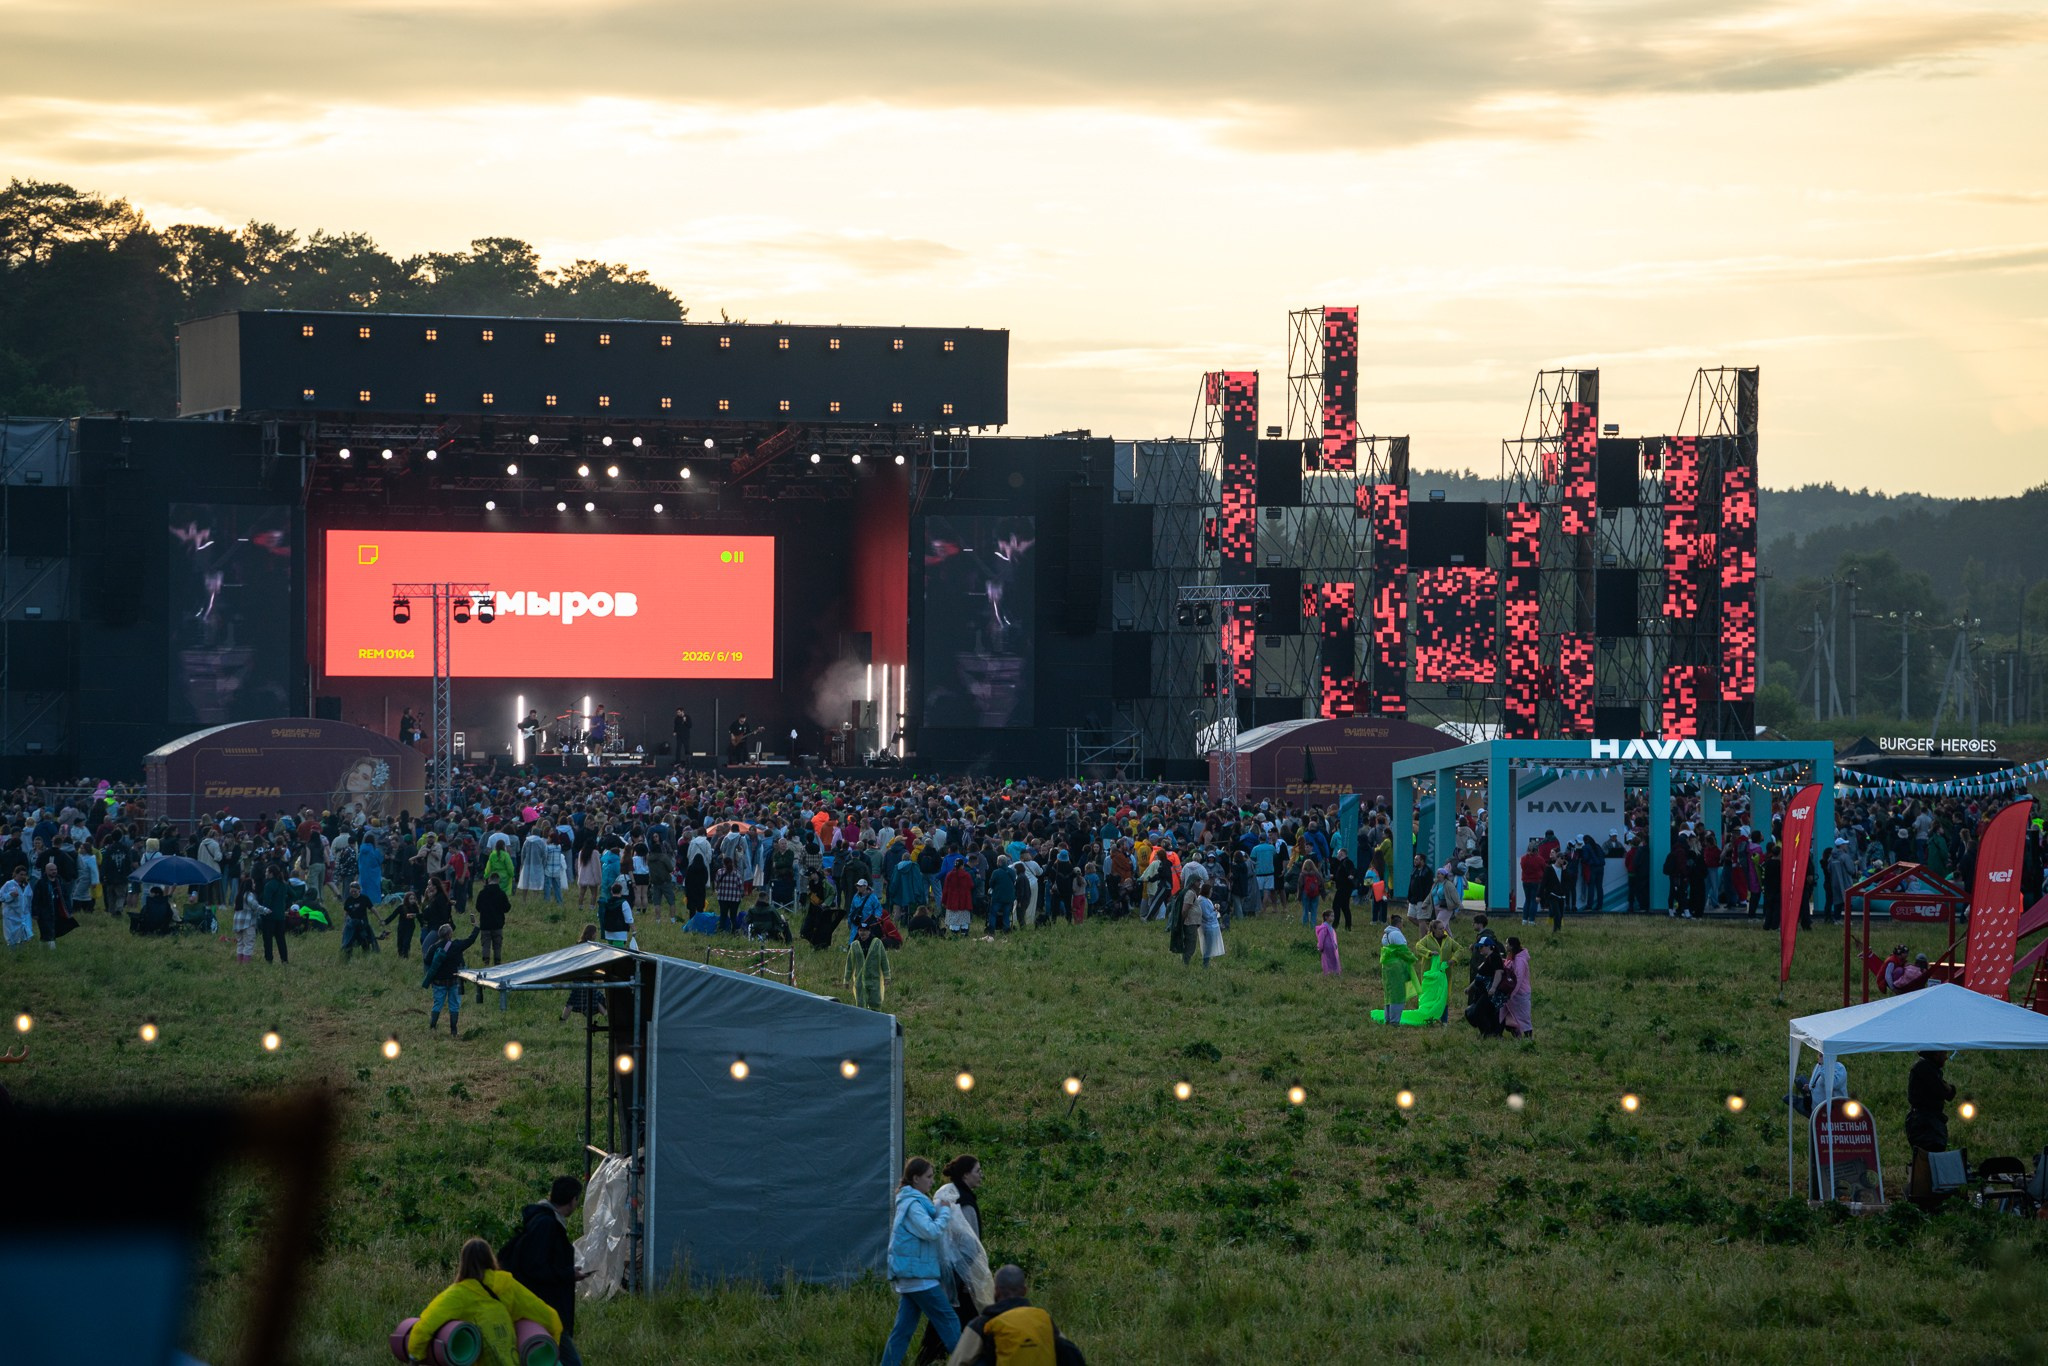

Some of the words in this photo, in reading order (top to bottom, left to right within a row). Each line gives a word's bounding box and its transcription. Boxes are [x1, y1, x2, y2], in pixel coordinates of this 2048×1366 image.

[358, 648, 385, 659] REM
[386, 648, 415, 659] 0104
[1591, 738, 1732, 759] HAVAL
[1879, 737, 1935, 751] BURGER
[1941, 739, 1997, 752] HEROES
[204, 786, 281, 798] СИРЕНА
[1285, 784, 1354, 795] СИРЕНА
[1527, 800, 1616, 813] HAVAL
